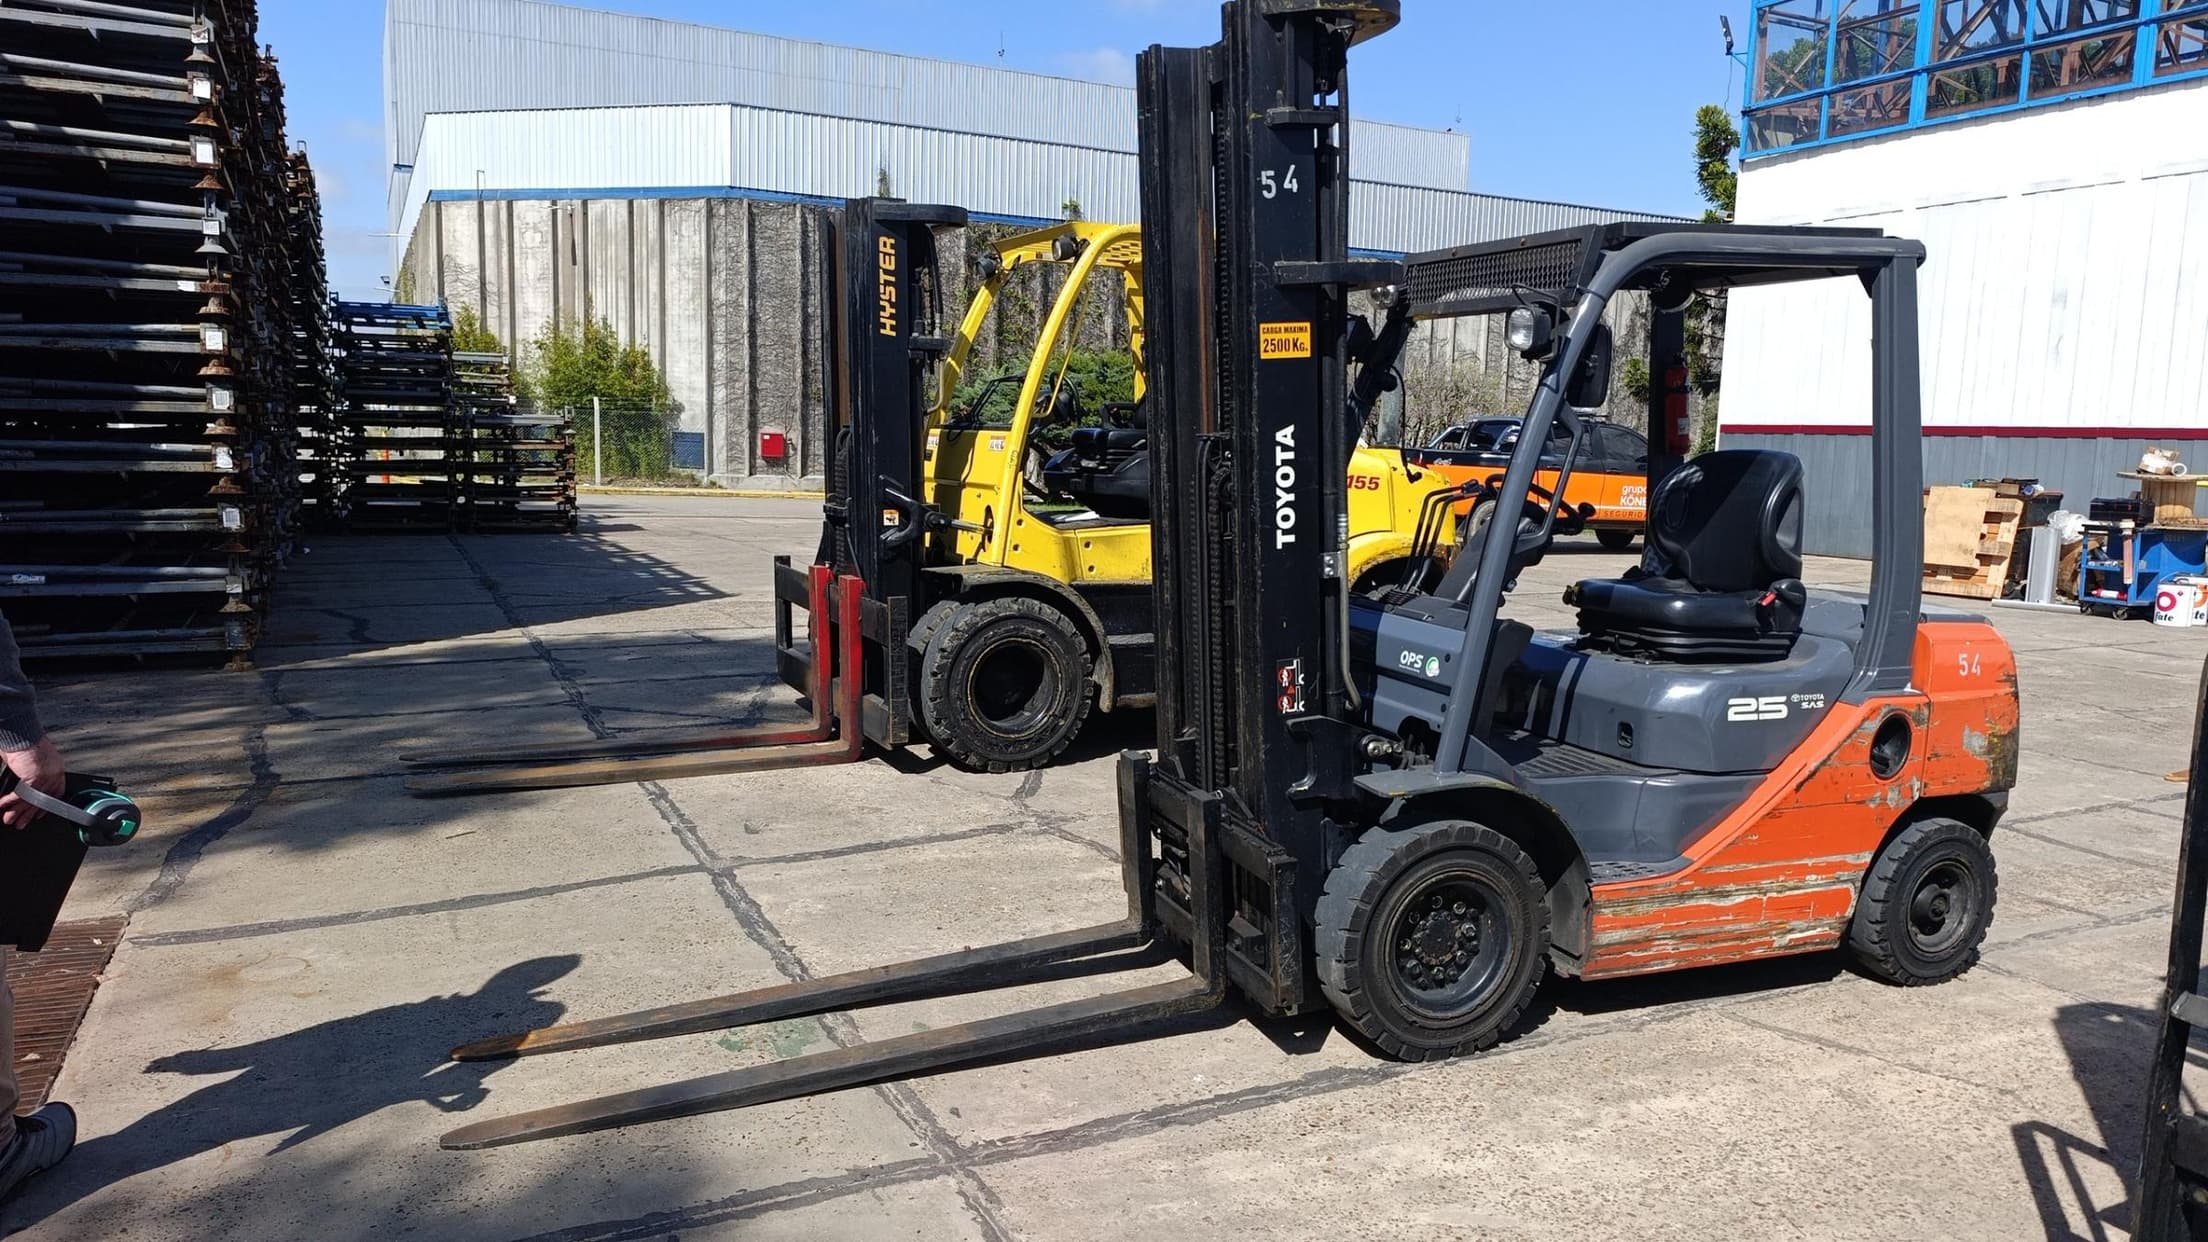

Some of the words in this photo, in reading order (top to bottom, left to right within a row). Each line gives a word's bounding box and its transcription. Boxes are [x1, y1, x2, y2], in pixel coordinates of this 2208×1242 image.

[1261, 164, 1298, 199] 54
[879, 236, 896, 337] HYSTER
[1275, 424, 1296, 549] TOYOTA
[1347, 475, 1380, 491] 155
[1400, 650, 1424, 668] OPS
[1957, 653, 1982, 677] 54
[1727, 695, 1789, 722] 25
[1800, 693, 1825, 702] TOYOTA
[1800, 701, 1825, 710] SAS
